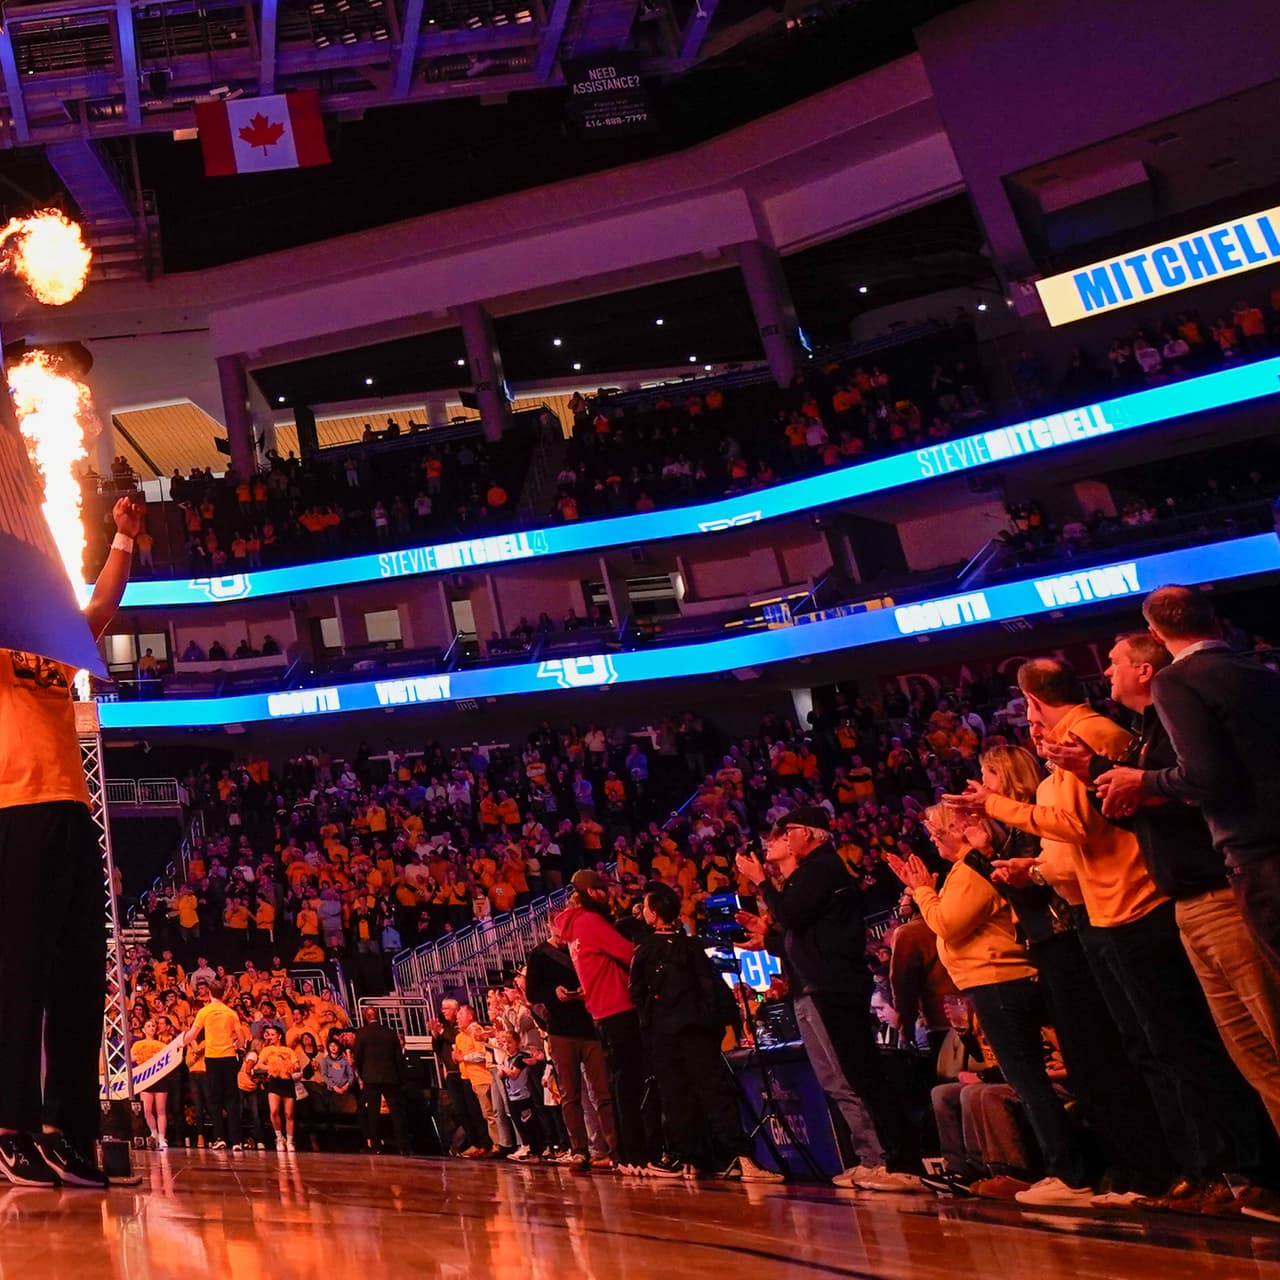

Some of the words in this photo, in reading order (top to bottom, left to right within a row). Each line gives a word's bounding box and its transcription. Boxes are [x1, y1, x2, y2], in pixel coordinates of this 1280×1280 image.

[572, 75, 641, 96] ASSISTANCE?
[588, 66, 617, 80] NEED
[916, 437, 989, 478] STEVIE
[380, 548, 436, 578] STEVIE
